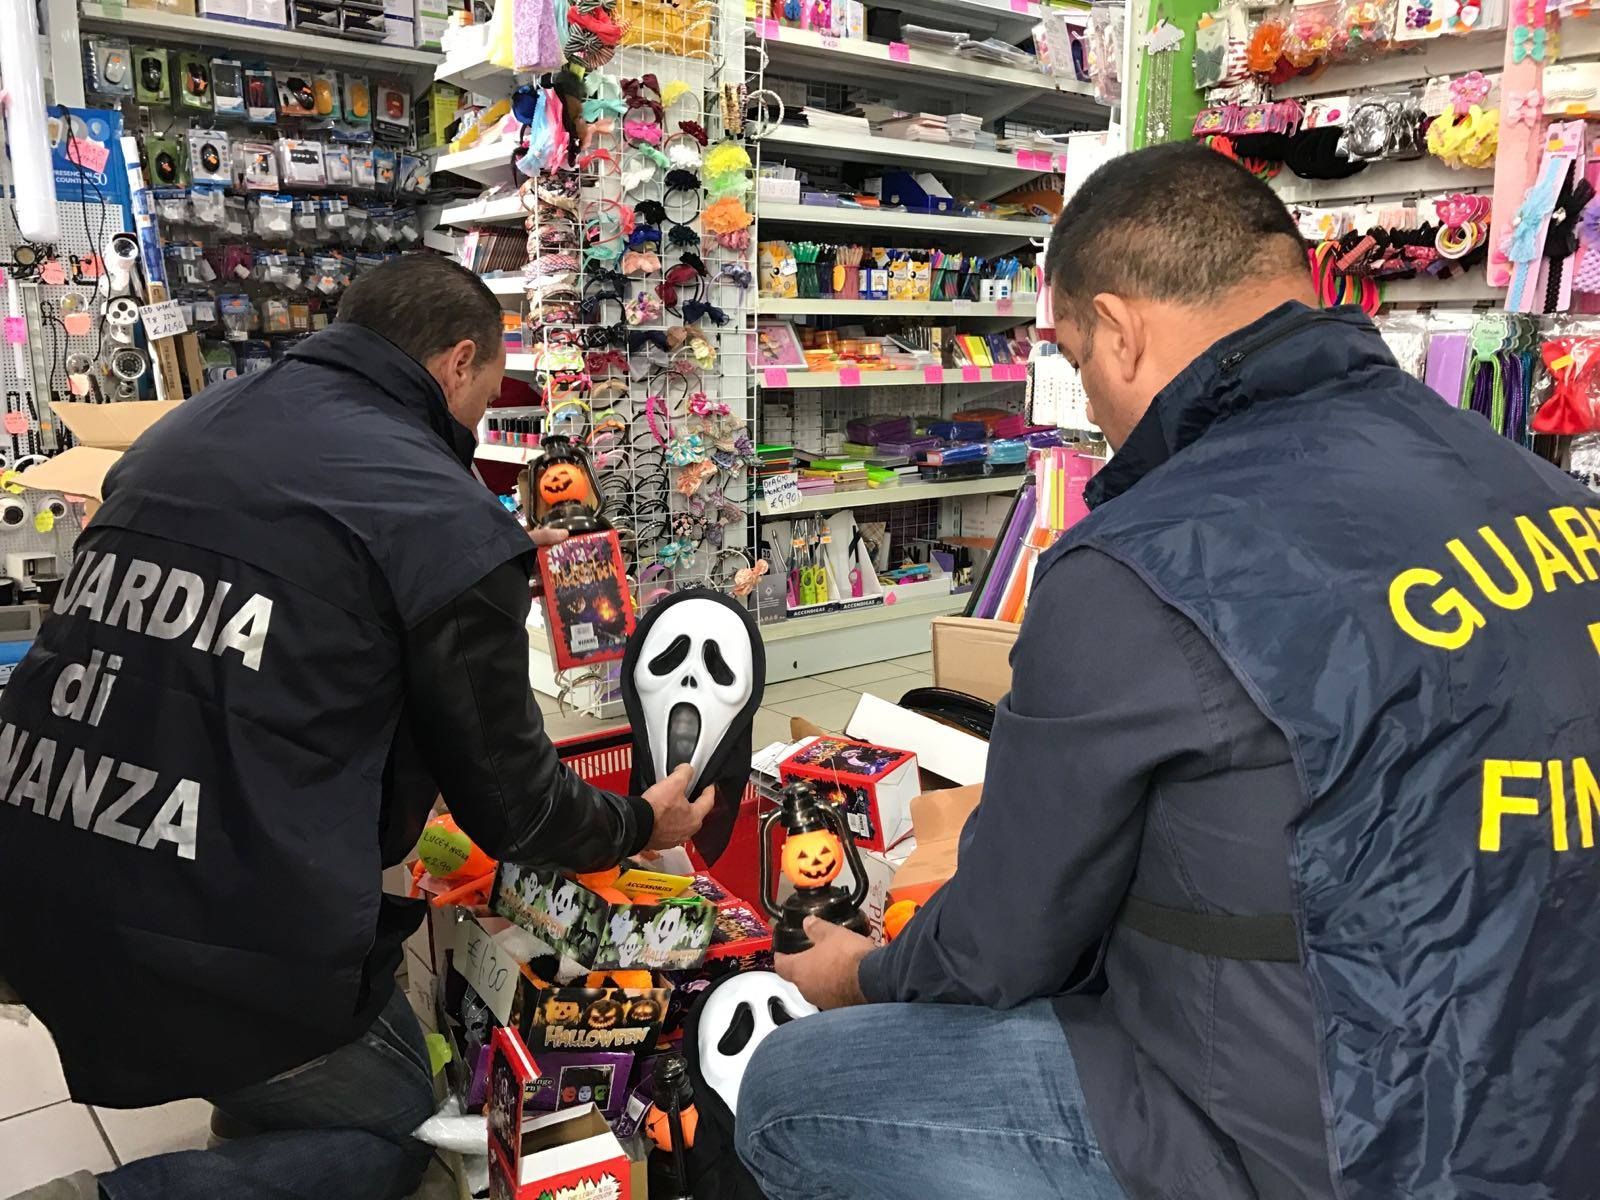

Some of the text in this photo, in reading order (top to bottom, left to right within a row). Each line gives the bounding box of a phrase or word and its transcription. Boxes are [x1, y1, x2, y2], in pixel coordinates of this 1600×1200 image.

[93, 172, 107, 186] 50
[53, 550, 273, 672] UARDIA
[51, 648, 123, 727] di
[545, 1025, 650, 1049] HALLOWEEN
